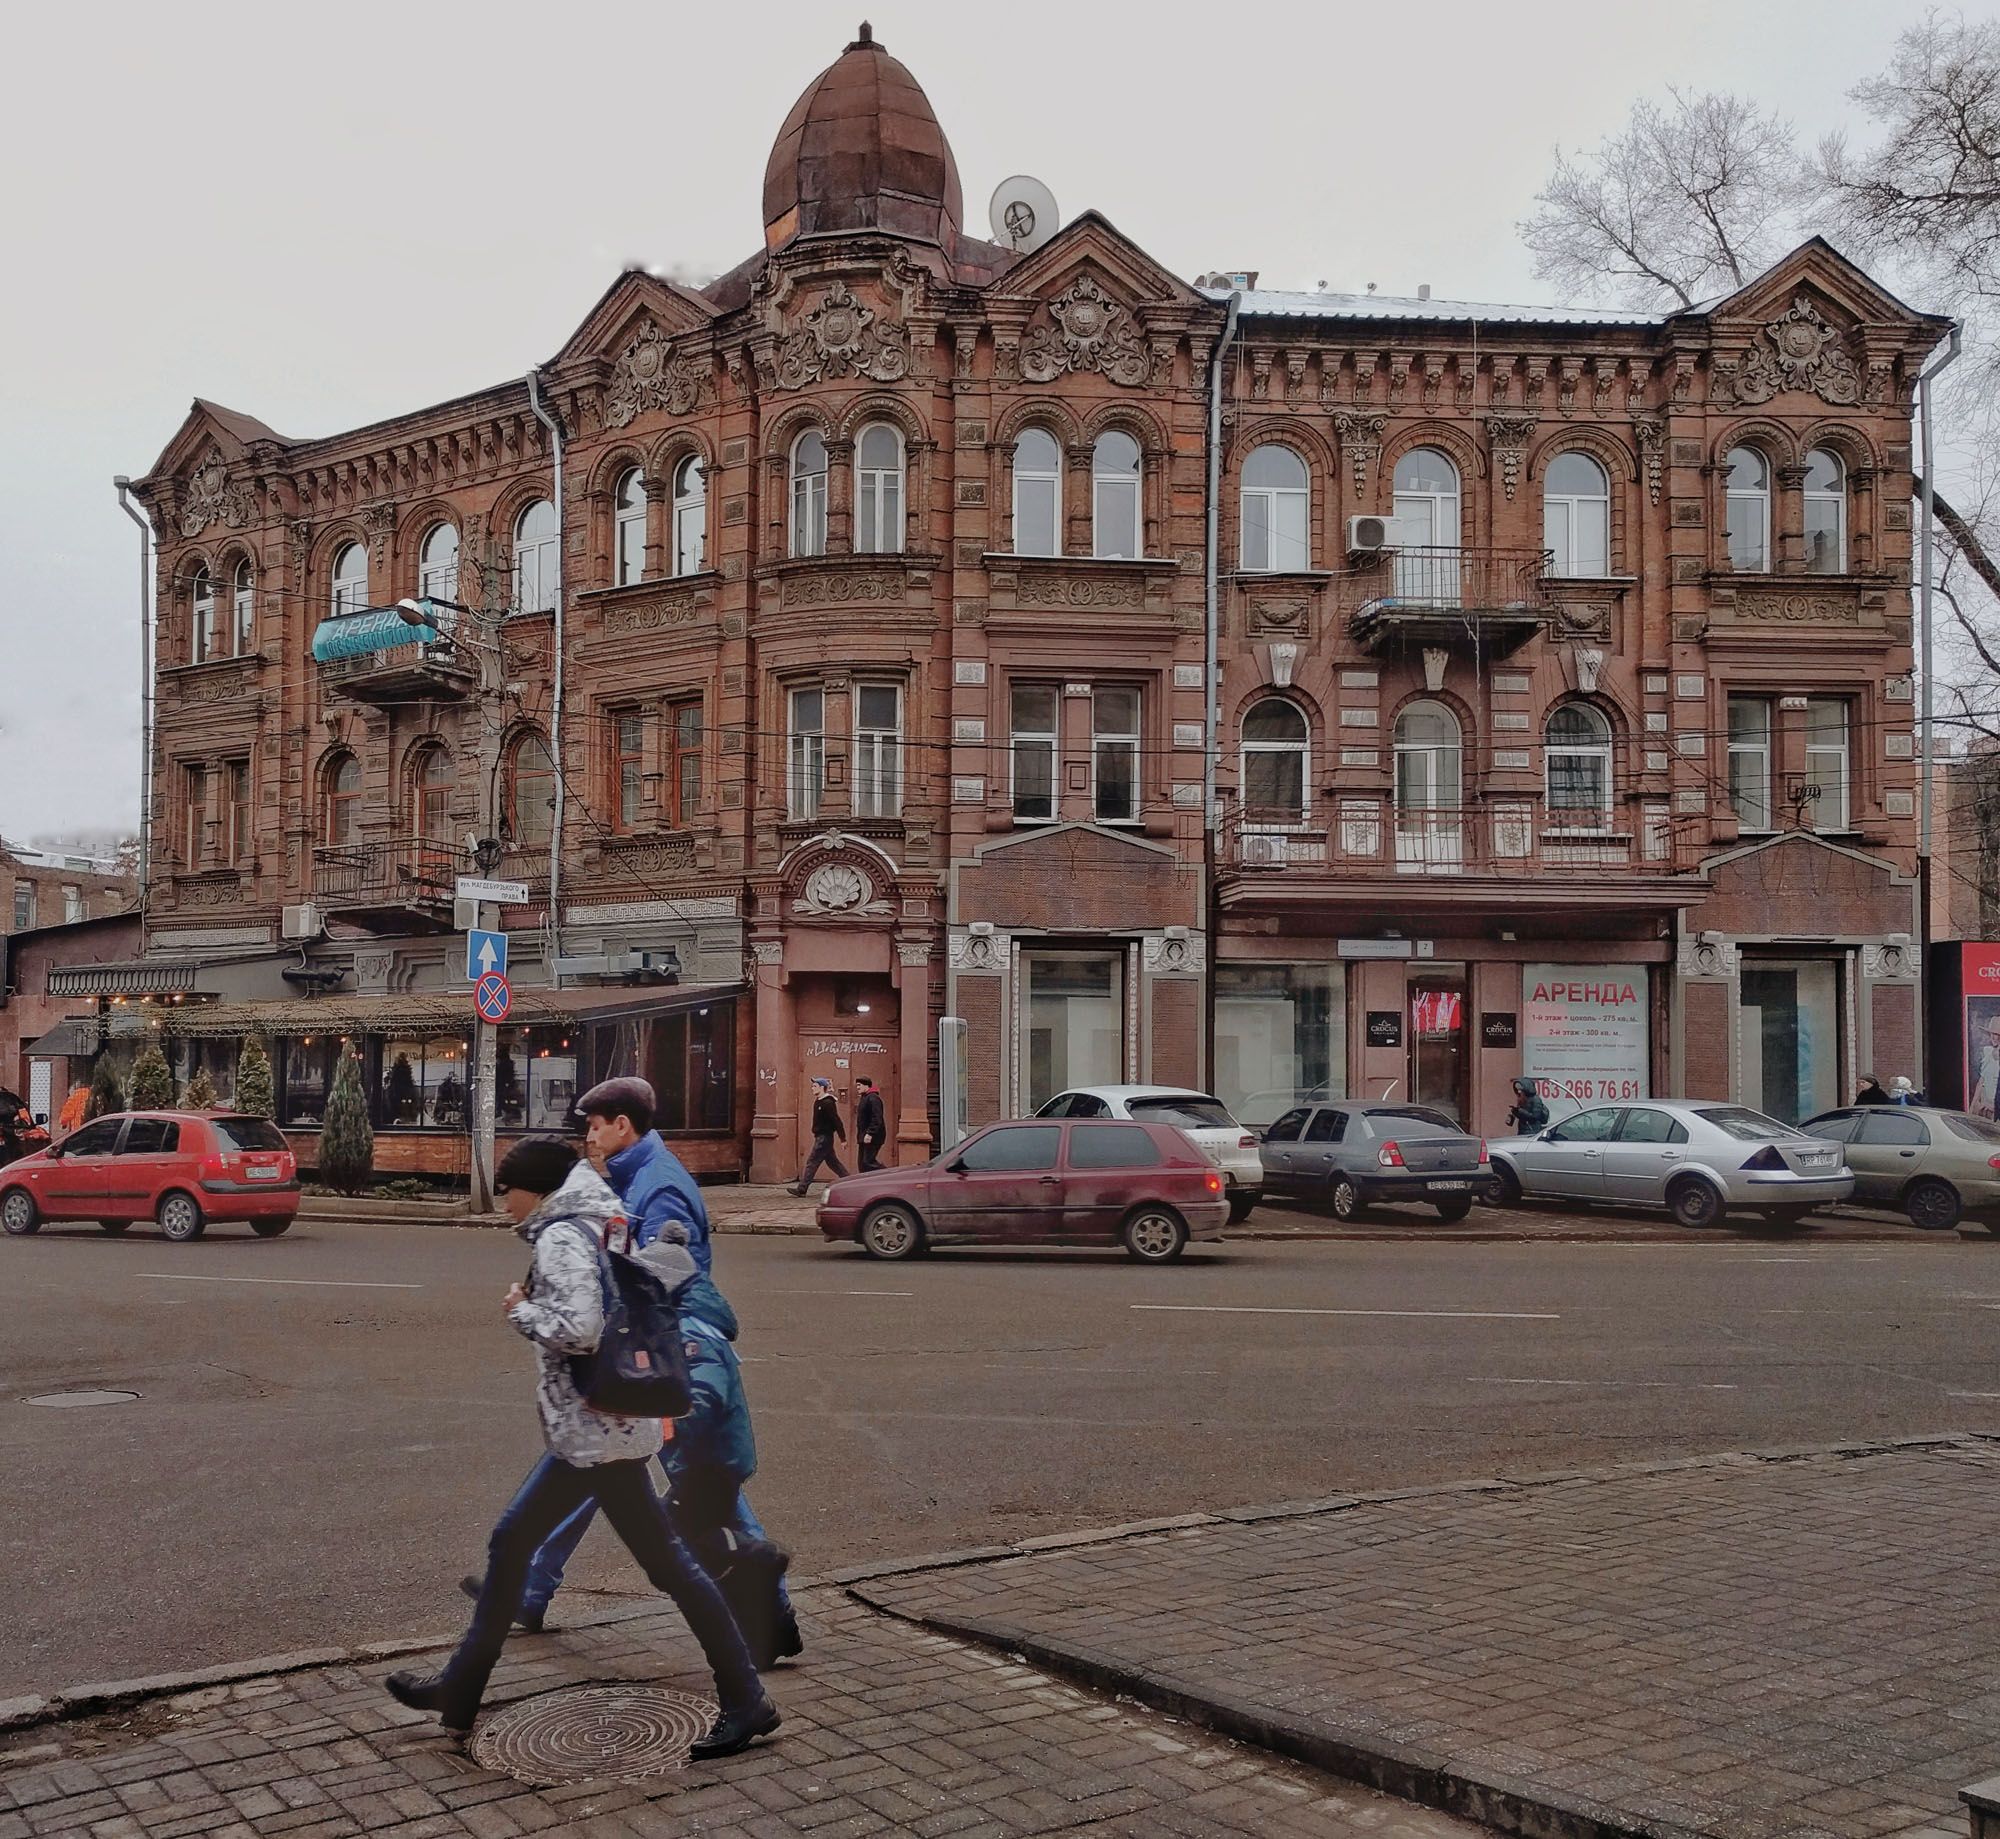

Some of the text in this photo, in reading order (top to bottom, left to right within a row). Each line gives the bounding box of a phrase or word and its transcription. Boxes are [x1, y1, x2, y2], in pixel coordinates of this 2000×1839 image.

[1532, 982, 1637, 1006] АРЕНДА
[1565, 1080, 1593, 1099] 266
[1598, 1080, 1617, 1099] 76
[1622, 1080, 1639, 1099] 61
